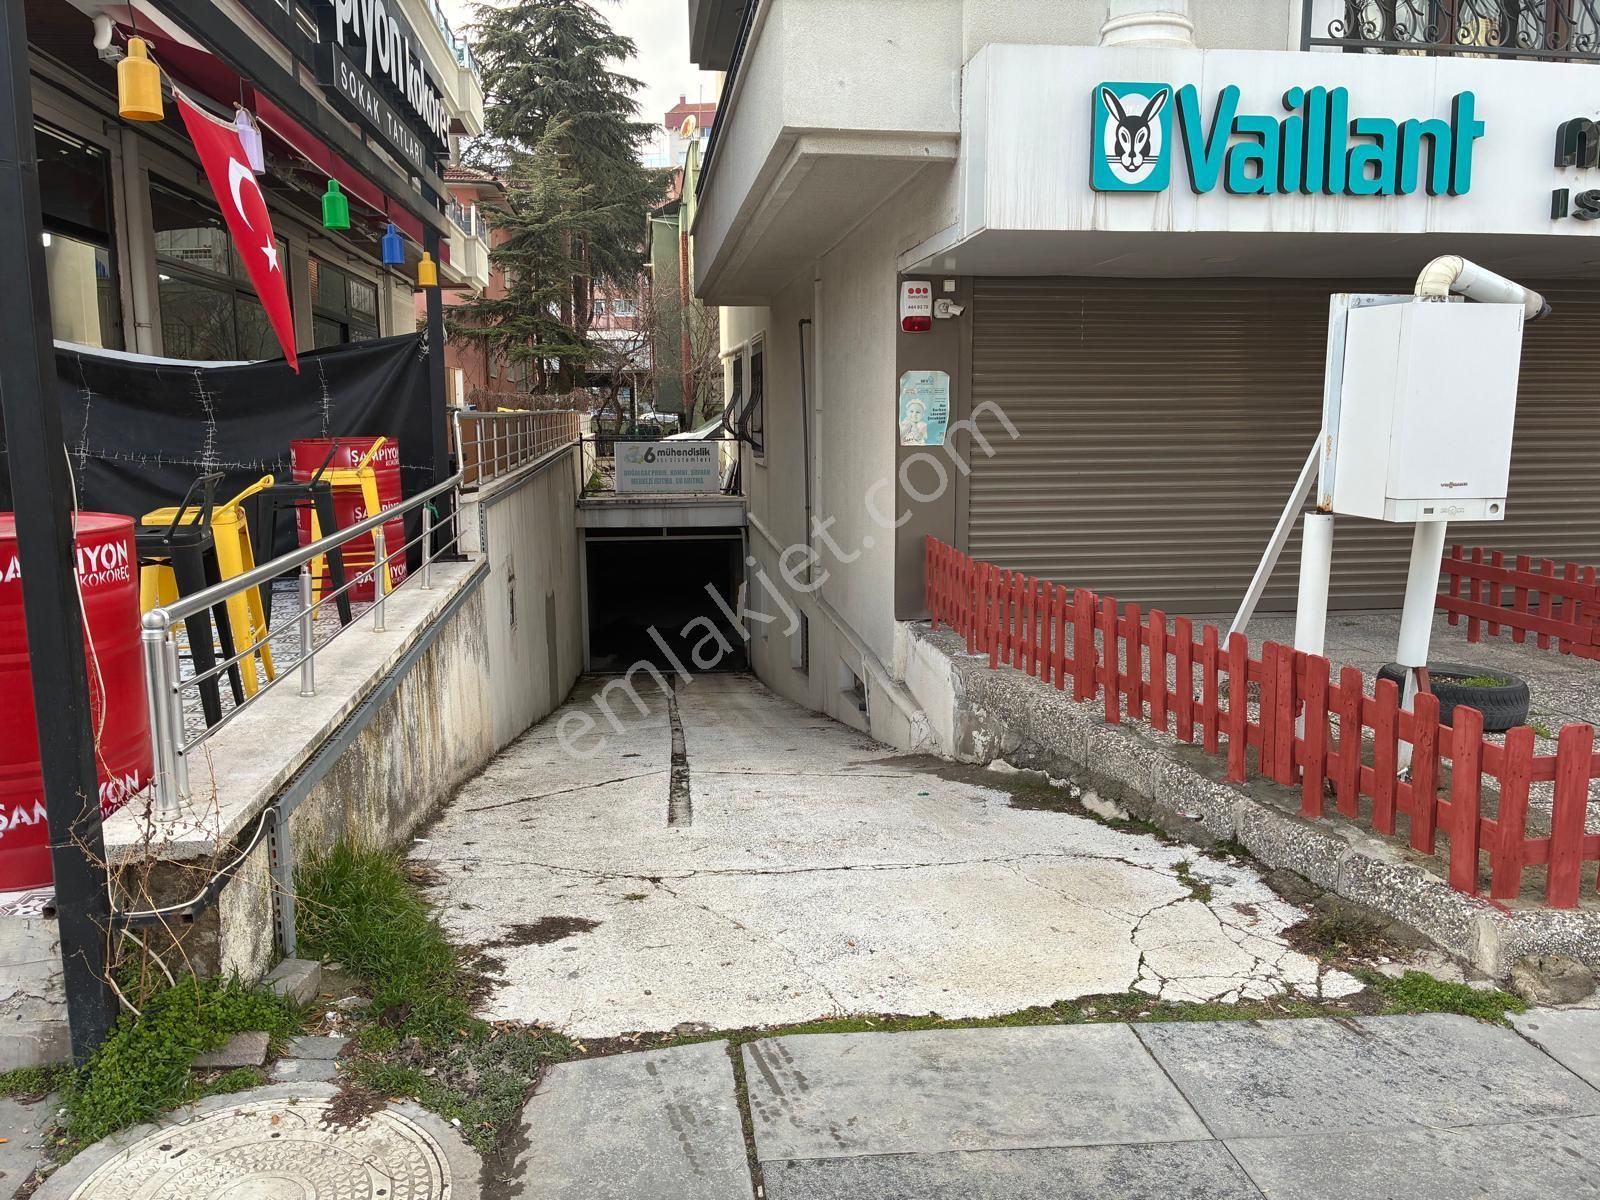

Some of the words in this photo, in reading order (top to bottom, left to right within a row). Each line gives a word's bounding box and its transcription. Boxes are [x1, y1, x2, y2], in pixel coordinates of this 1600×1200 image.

[340, 61, 380, 125] SOKAK
[386, 112, 423, 168] TATLARI
[1175, 83, 1485, 196] Vaillant
[657, 447, 710, 456] mühendislik
[80, 565, 130, 588] KOKOREÇ
